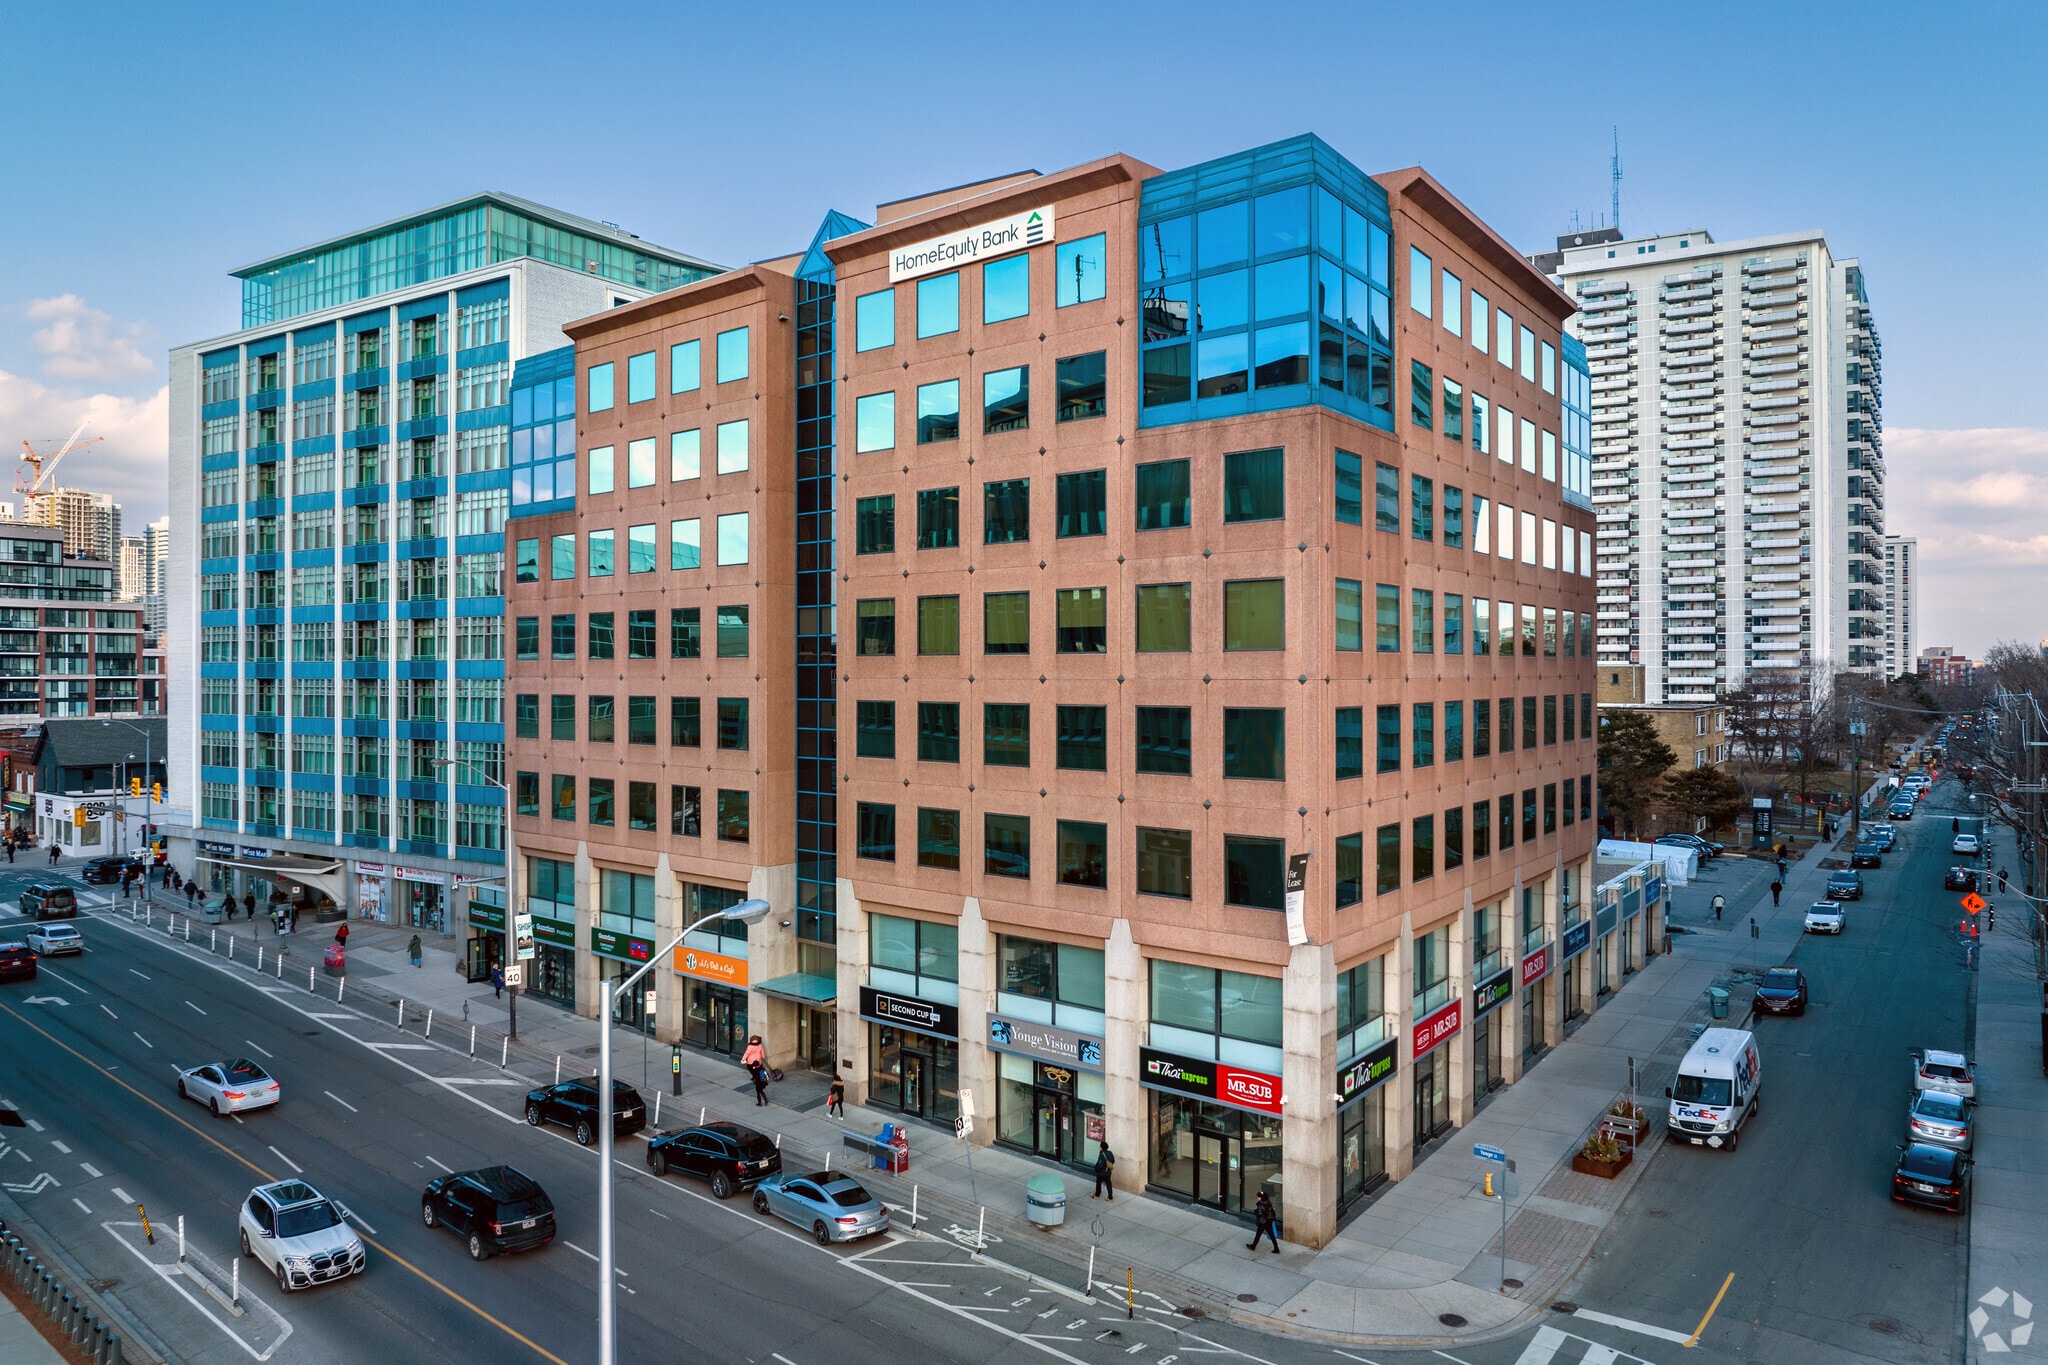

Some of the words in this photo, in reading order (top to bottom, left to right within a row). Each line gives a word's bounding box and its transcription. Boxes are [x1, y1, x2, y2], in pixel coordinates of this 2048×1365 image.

[896, 236, 979, 273] HomeEquity
[982, 224, 1019, 249] Bank
[1287, 879, 1302, 888] Lease
[1288, 870, 1298, 879] For
[1524, 954, 1544, 980] MR.SUB
[507, 973, 520, 983] 40
[891, 1004, 916, 1016] SECOND
[916, 1010, 929, 1019] CUP
[1433, 1011, 1457, 1039] MR.SUB
[1011, 1026, 1043, 1048] Yonge
[1043, 1033, 1077, 1054] Vision
[1371, 1056, 1391, 1079] express
[1736, 1046, 1758, 1092] FedEx
[1181, 1070, 1208, 1086] express
[1227, 1079, 1273, 1099] MR.SUB
[1677, 1107, 1718, 1121] FedEx
